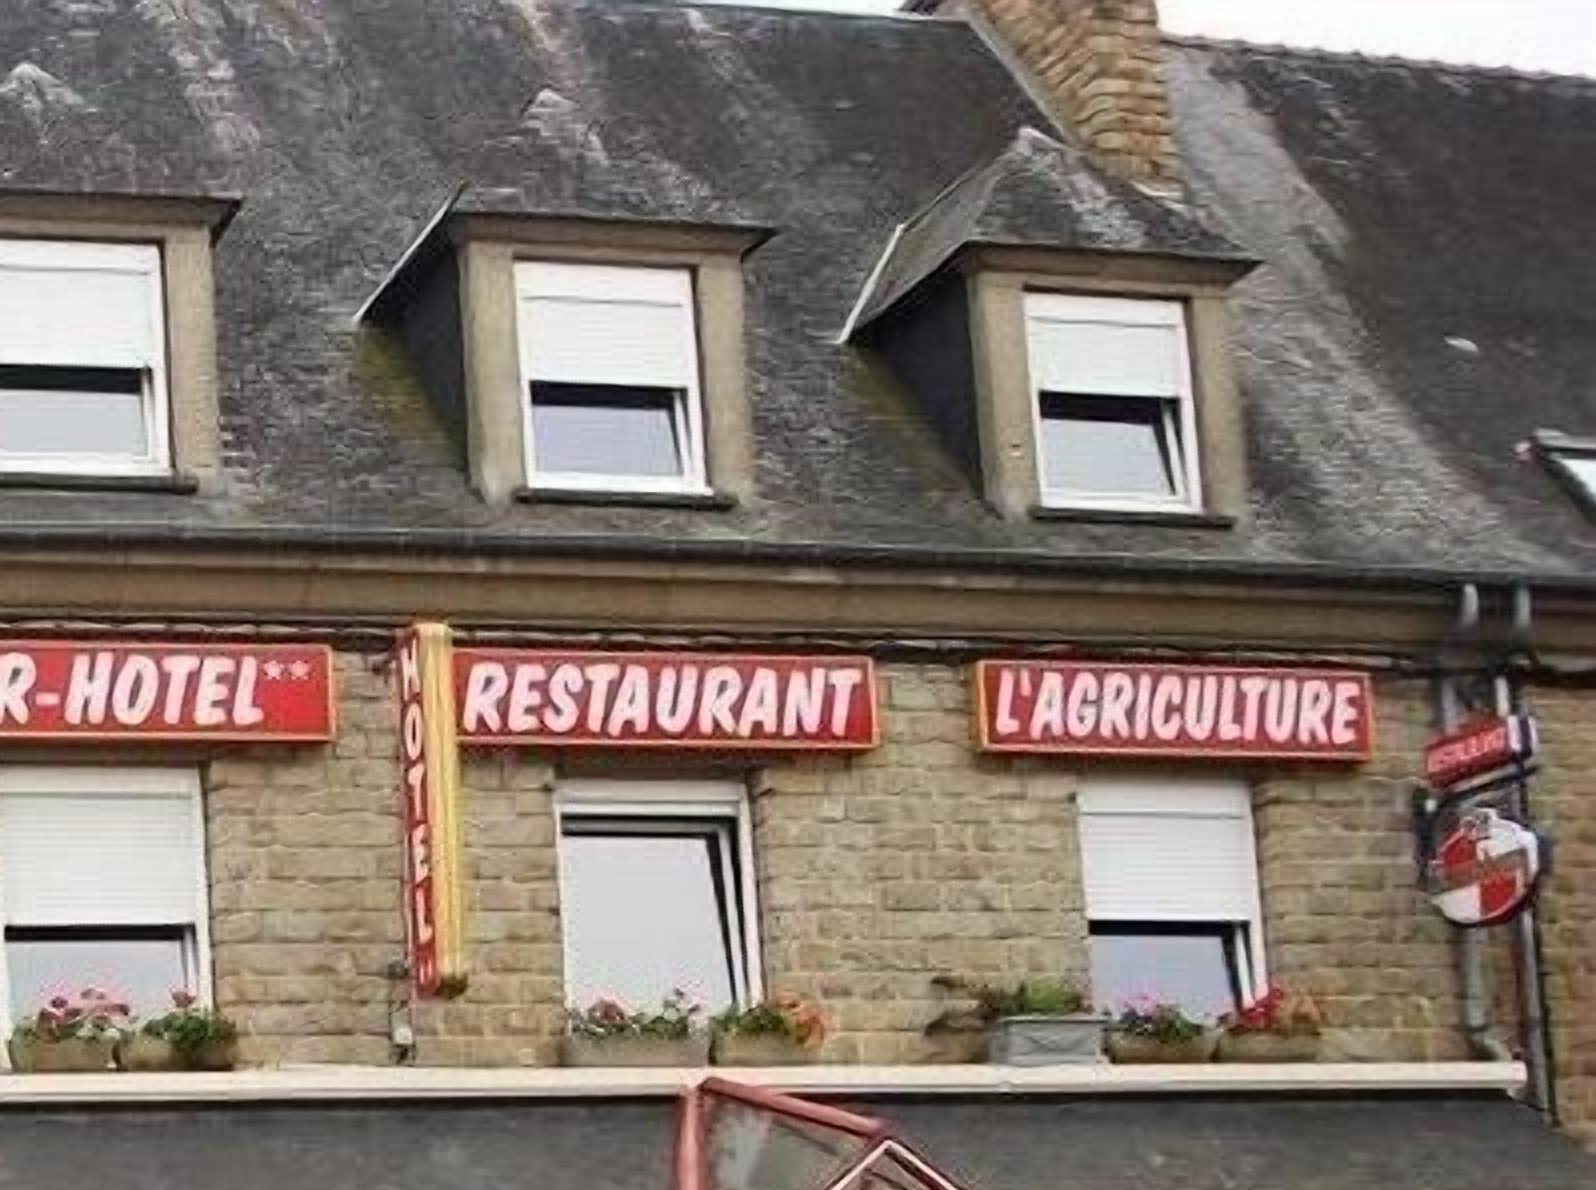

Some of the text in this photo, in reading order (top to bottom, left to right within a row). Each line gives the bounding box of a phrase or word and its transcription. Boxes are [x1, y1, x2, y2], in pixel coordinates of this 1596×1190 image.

[463, 661, 863, 738] RESTAURANT
[995, 669, 1361, 745] L'AGRICULTURE
[403, 640, 433, 946] HOTEL
